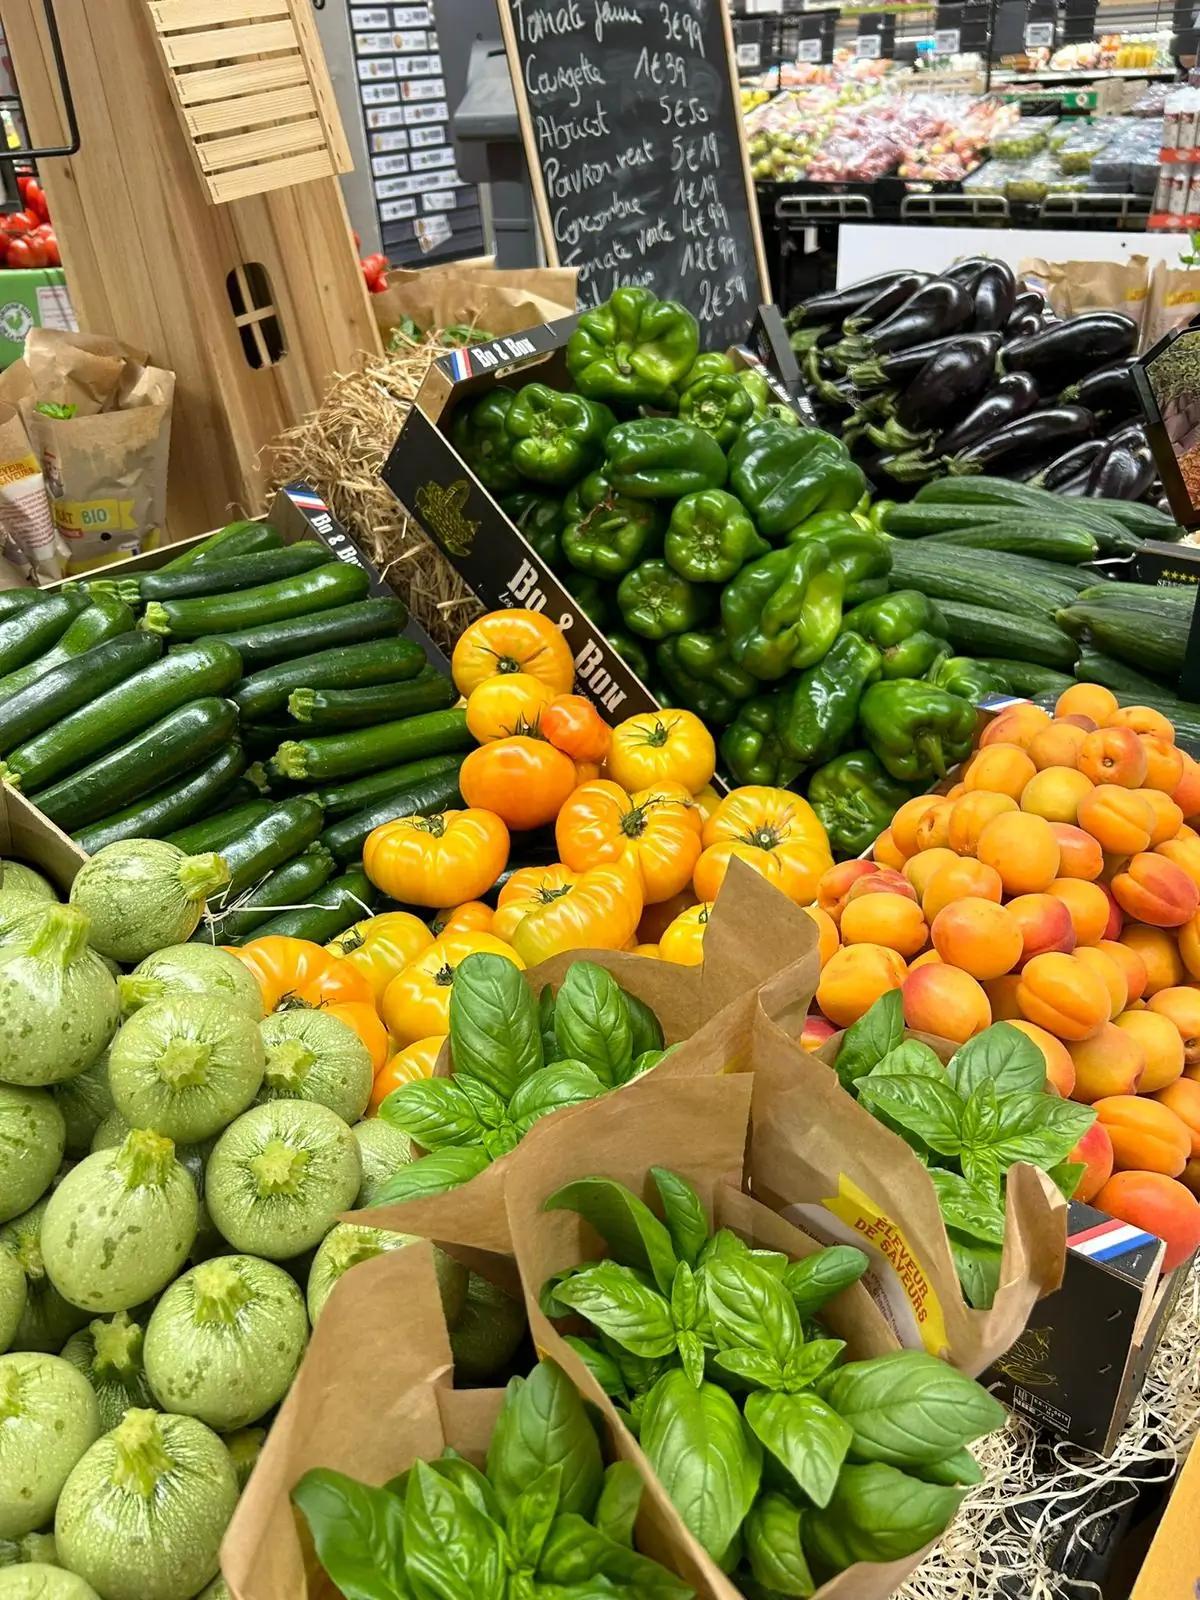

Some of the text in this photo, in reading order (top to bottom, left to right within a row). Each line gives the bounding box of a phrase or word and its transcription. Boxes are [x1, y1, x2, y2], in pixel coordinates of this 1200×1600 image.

[512, 0, 586, 44] Tomate
[659, 3, 705, 58] 3€99
[526, 53, 606, 107] Courgette
[634, 47, 687, 88] 1€39
[536, 96, 709, 152] Abricot 5€50
[671, 132, 720, 172] 5€19
[673, 174, 719, 209] 1€19
[682, 202, 730, 237] 4€99
[680, 237, 737, 277] 12€99
[699, 275, 749, 322] 2€59
[492, 342, 510, 361] &
[82, 508, 107, 525] BIO
[327, 534, 346, 546] &
[854, 1217, 878, 1241] DE
[879, 1240, 928, 1323] SAVEURS
[874, 1216, 929, 1300] ÉLEVEUR
